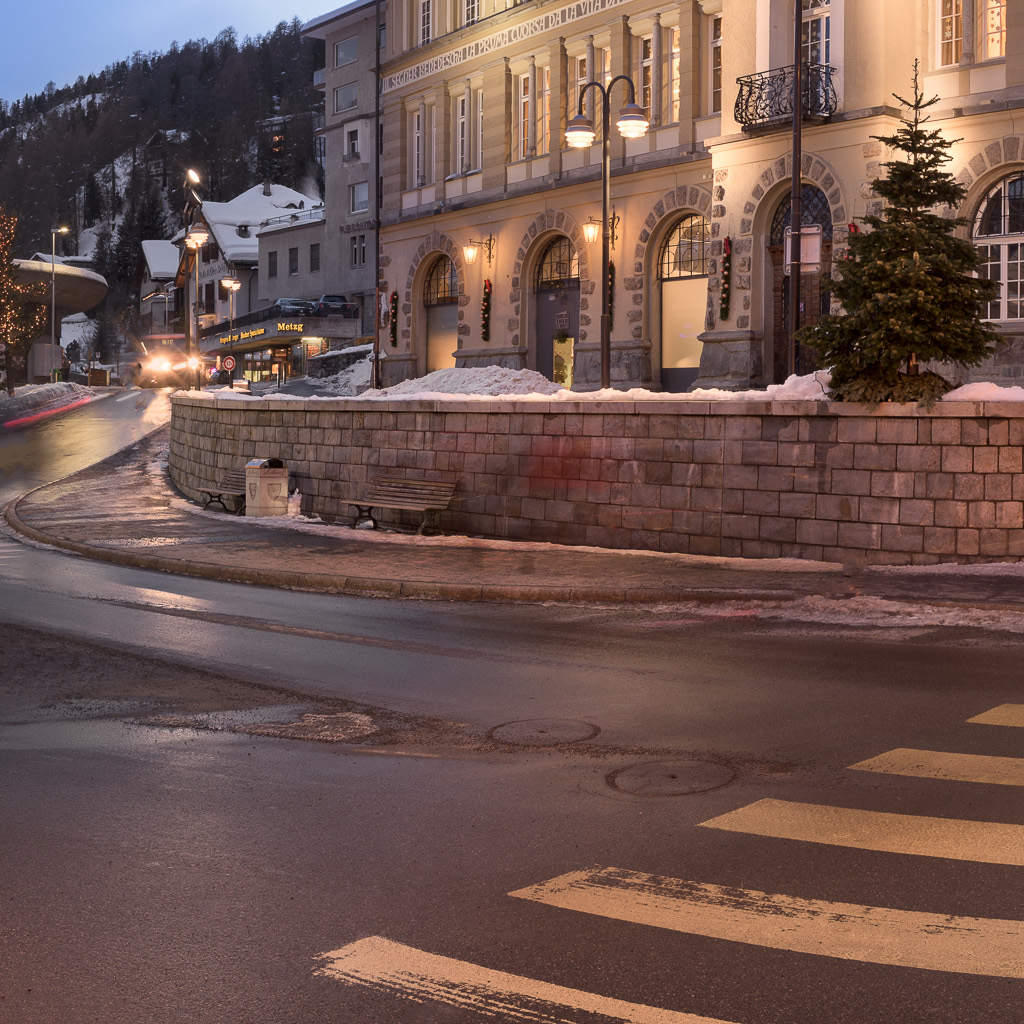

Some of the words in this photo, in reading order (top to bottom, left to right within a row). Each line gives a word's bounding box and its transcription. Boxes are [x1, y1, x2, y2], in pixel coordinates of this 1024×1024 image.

[511, 18, 545, 41] CUORSA
[549, 12, 560, 27] DA
[566, 7, 577, 20] LA
[277, 323, 304, 333] Metzg
